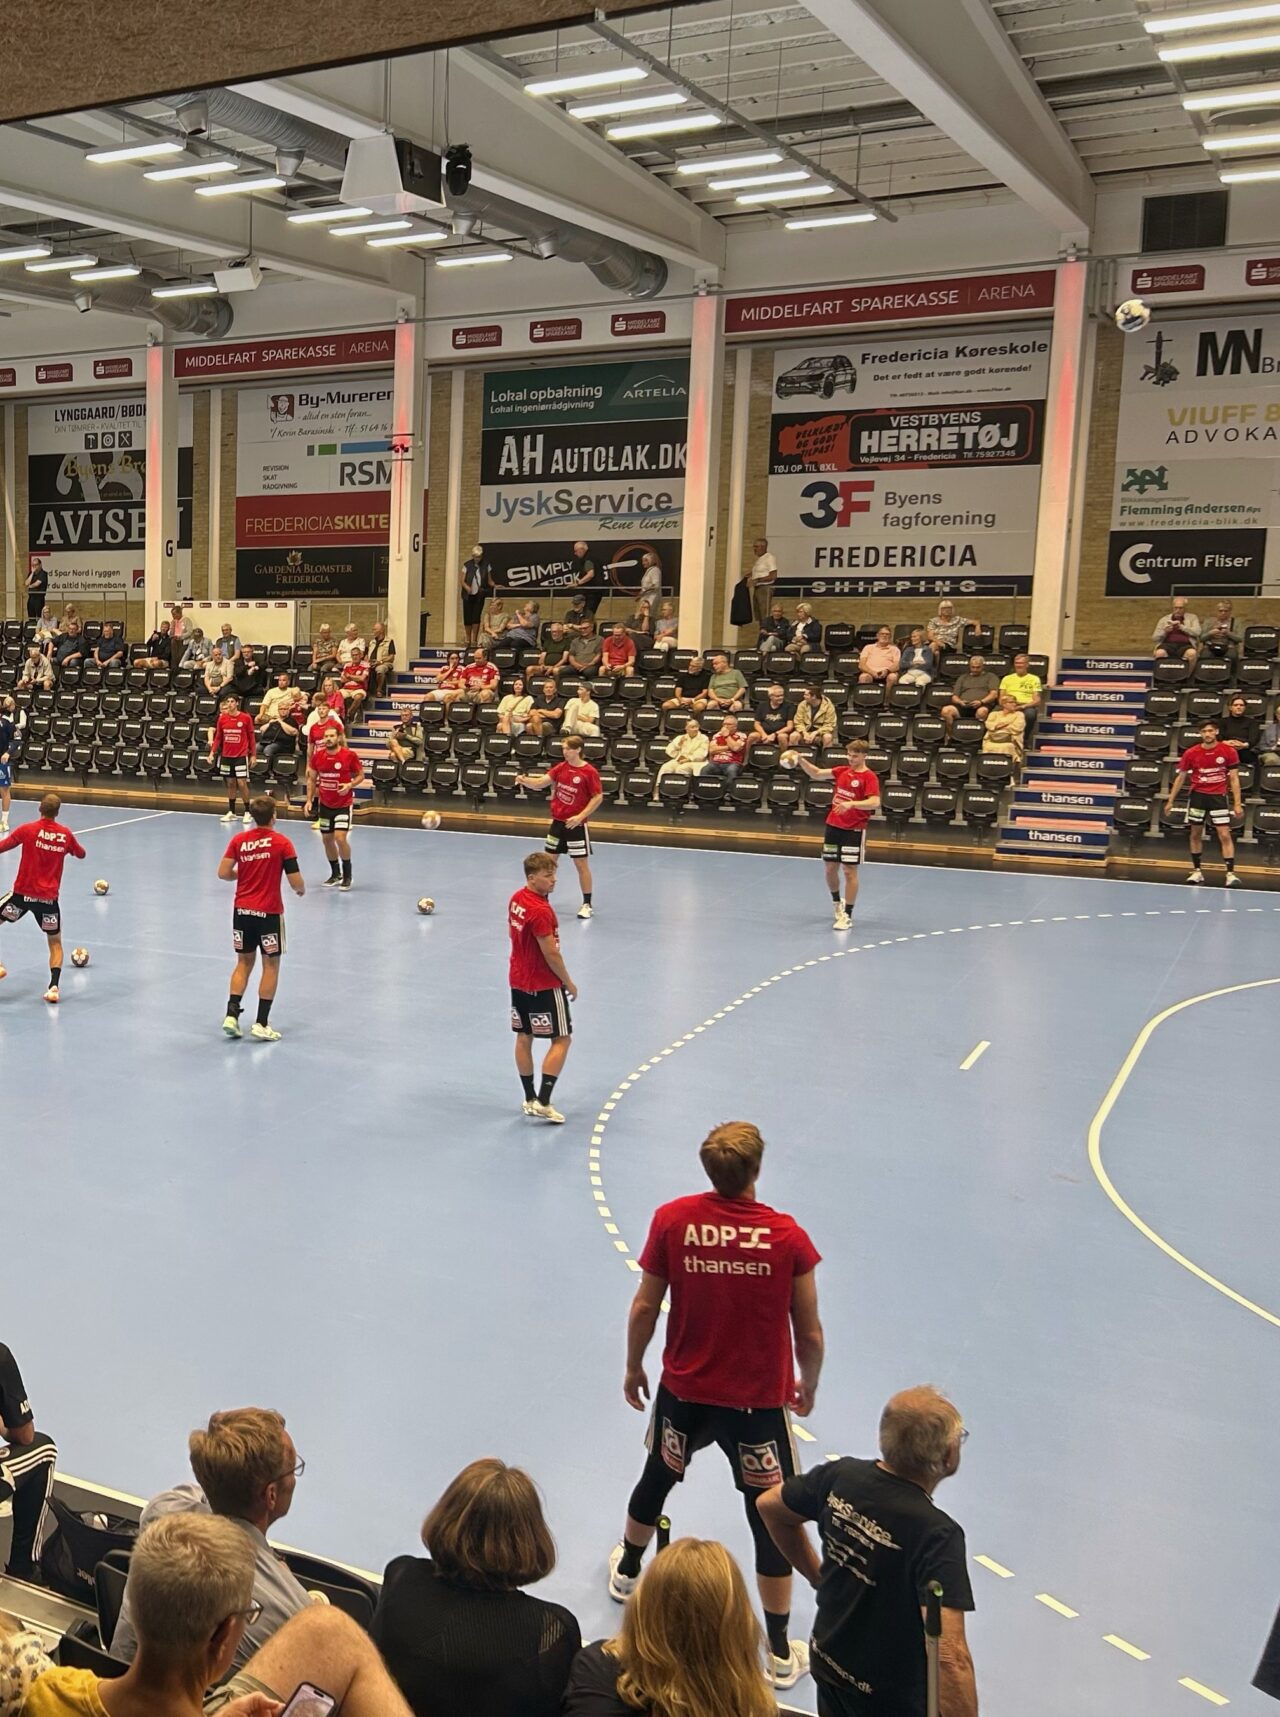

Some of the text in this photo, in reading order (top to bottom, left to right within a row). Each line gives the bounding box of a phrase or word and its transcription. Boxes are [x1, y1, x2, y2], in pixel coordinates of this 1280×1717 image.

[740, 283, 1036, 322] MIDDELFART SPAREKASSE ARENA
[185, 340, 389, 368] MIDDELFART SPAREKASSE ARENA
[861, 341, 1049, 365] Fredericia Køreskole
[1196, 328, 1264, 377] MN
[490, 384, 687, 403] Lokal opbakning ARTELIA
[490, 405, 513, 414] Lokal
[1167, 404, 1258, 427] VIUFF
[890, 411, 982, 429] VESTBYENS
[859, 423, 1019, 454] HERRETØJ
[1165, 426, 1278, 445] ADVOKA
[498, 434, 688, 476] AH AUTOLAK.DK
[894, 454, 906, 462] 34
[913, 452, 957, 461] Fredericia
[262, 464, 290, 472] REVISION
[773, 463, 838, 473] TØJ OP TIL 8XL
[262, 482, 298, 490] RÅDGIVNING
[486, 486, 673, 523] JyskService
[800, 480, 875, 529] 3F
[884, 491, 943, 509] Byens
[1119, 503, 1246, 517] Flemming Andersen
[36, 506, 184, 546] AVISE
[598, 516, 680, 532] Rene linjer
[882, 511, 996, 530] fagforening
[165, 539, 173, 558] G
[412, 533, 420, 553] G
[814, 544, 977, 568] FREDERICIA
[1118, 542, 1253, 584] Centrum Fliser
[54, 569, 71, 580] Spar
[72, 569, 89, 577] Nord
[95, 569, 121, 580] ryggen
[254, 563, 353, 575] GARDENIA BLOMSTER
[506, 560, 574, 587] SIMPLY
[51, 580, 127, 592] du altid hjemmebane
[275, 574, 331, 584] FREDERICIA
[811, 580, 978, 594] SHIPPING
[1086, 659, 1134, 670] thansen
[1075, 690, 1125, 702] thansen
[1064, 723, 1115, 735] thansen
[1053, 757, 1104, 769] thansen
[1041, 792, 1094, 805] thansen
[1028, 829, 1082, 844] thansen
[683, 1255, 772, 1276] thansen
